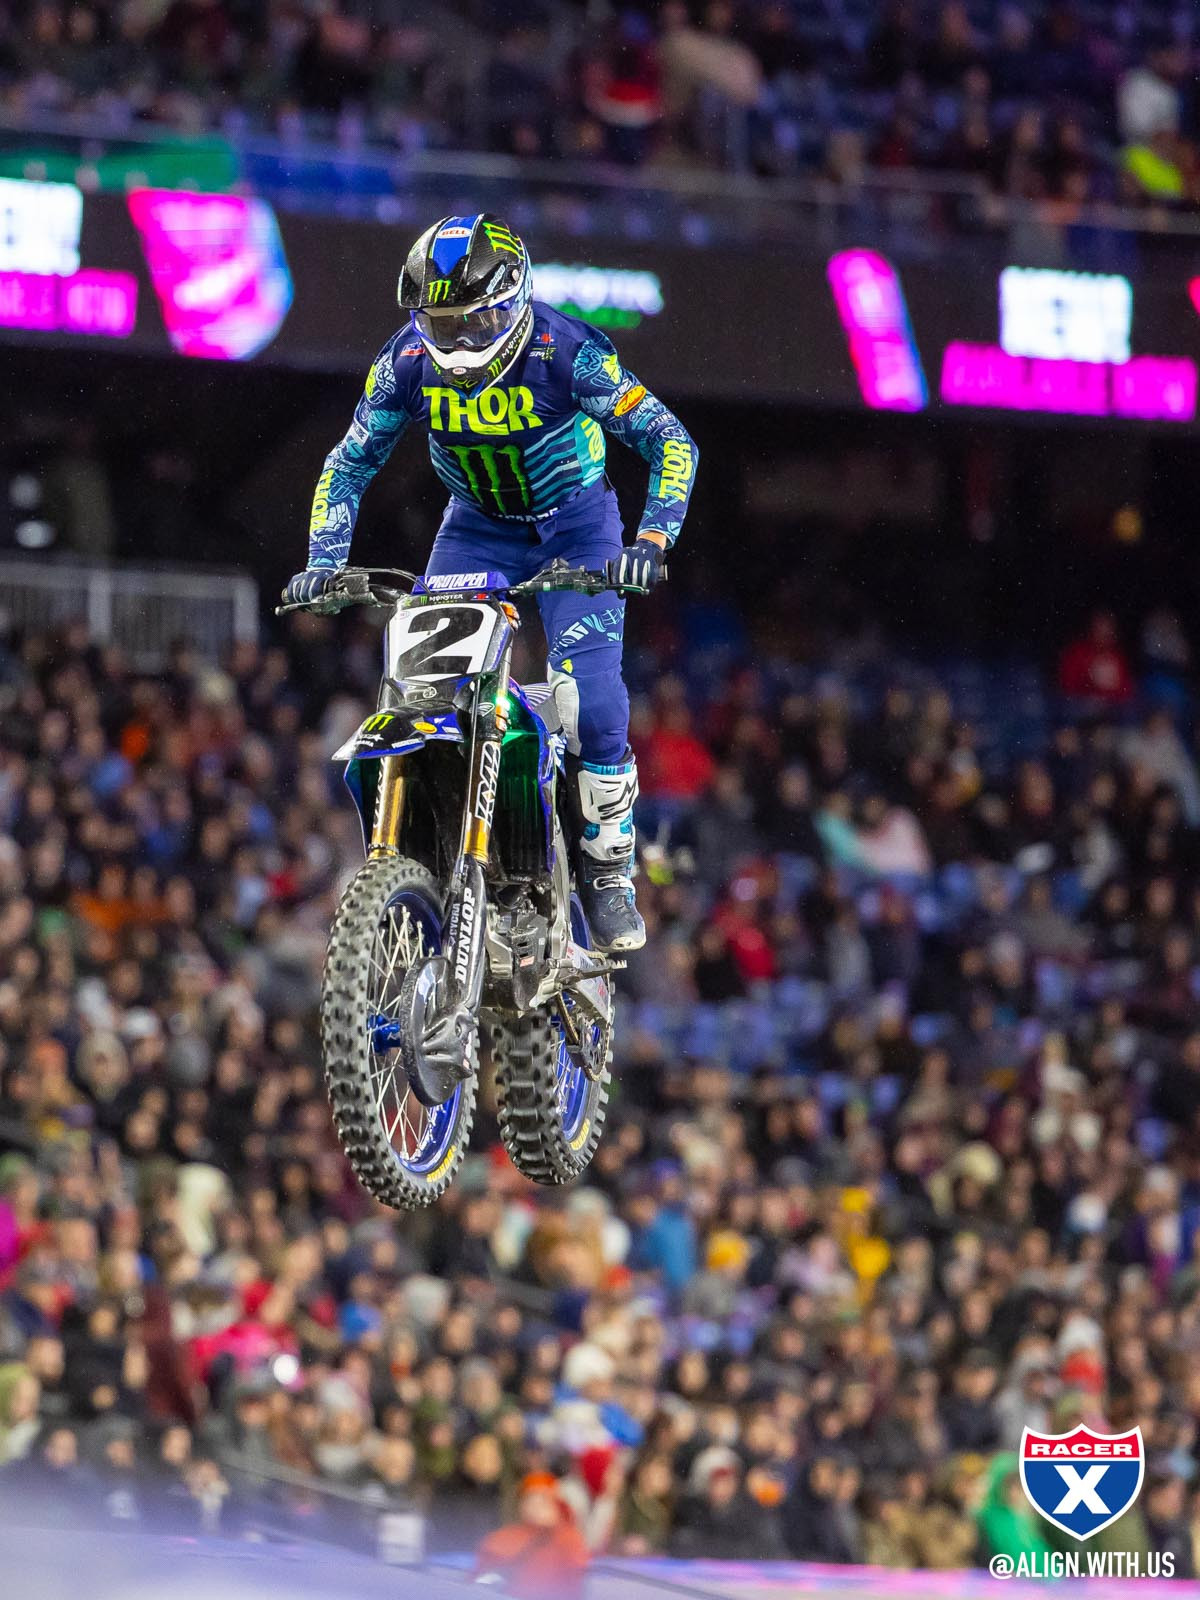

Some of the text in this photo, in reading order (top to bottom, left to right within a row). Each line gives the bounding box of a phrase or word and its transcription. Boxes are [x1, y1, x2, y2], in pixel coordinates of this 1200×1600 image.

[422, 386, 543, 435] THOR
[659, 439, 693, 502] THOR
[427, 573, 484, 588] PROTAPER
[429, 593, 463, 601] MONSTER
[395, 607, 484, 679] 2
[449, 903, 461, 936] CYCRA
[455, 887, 476, 984] DUNLOP
